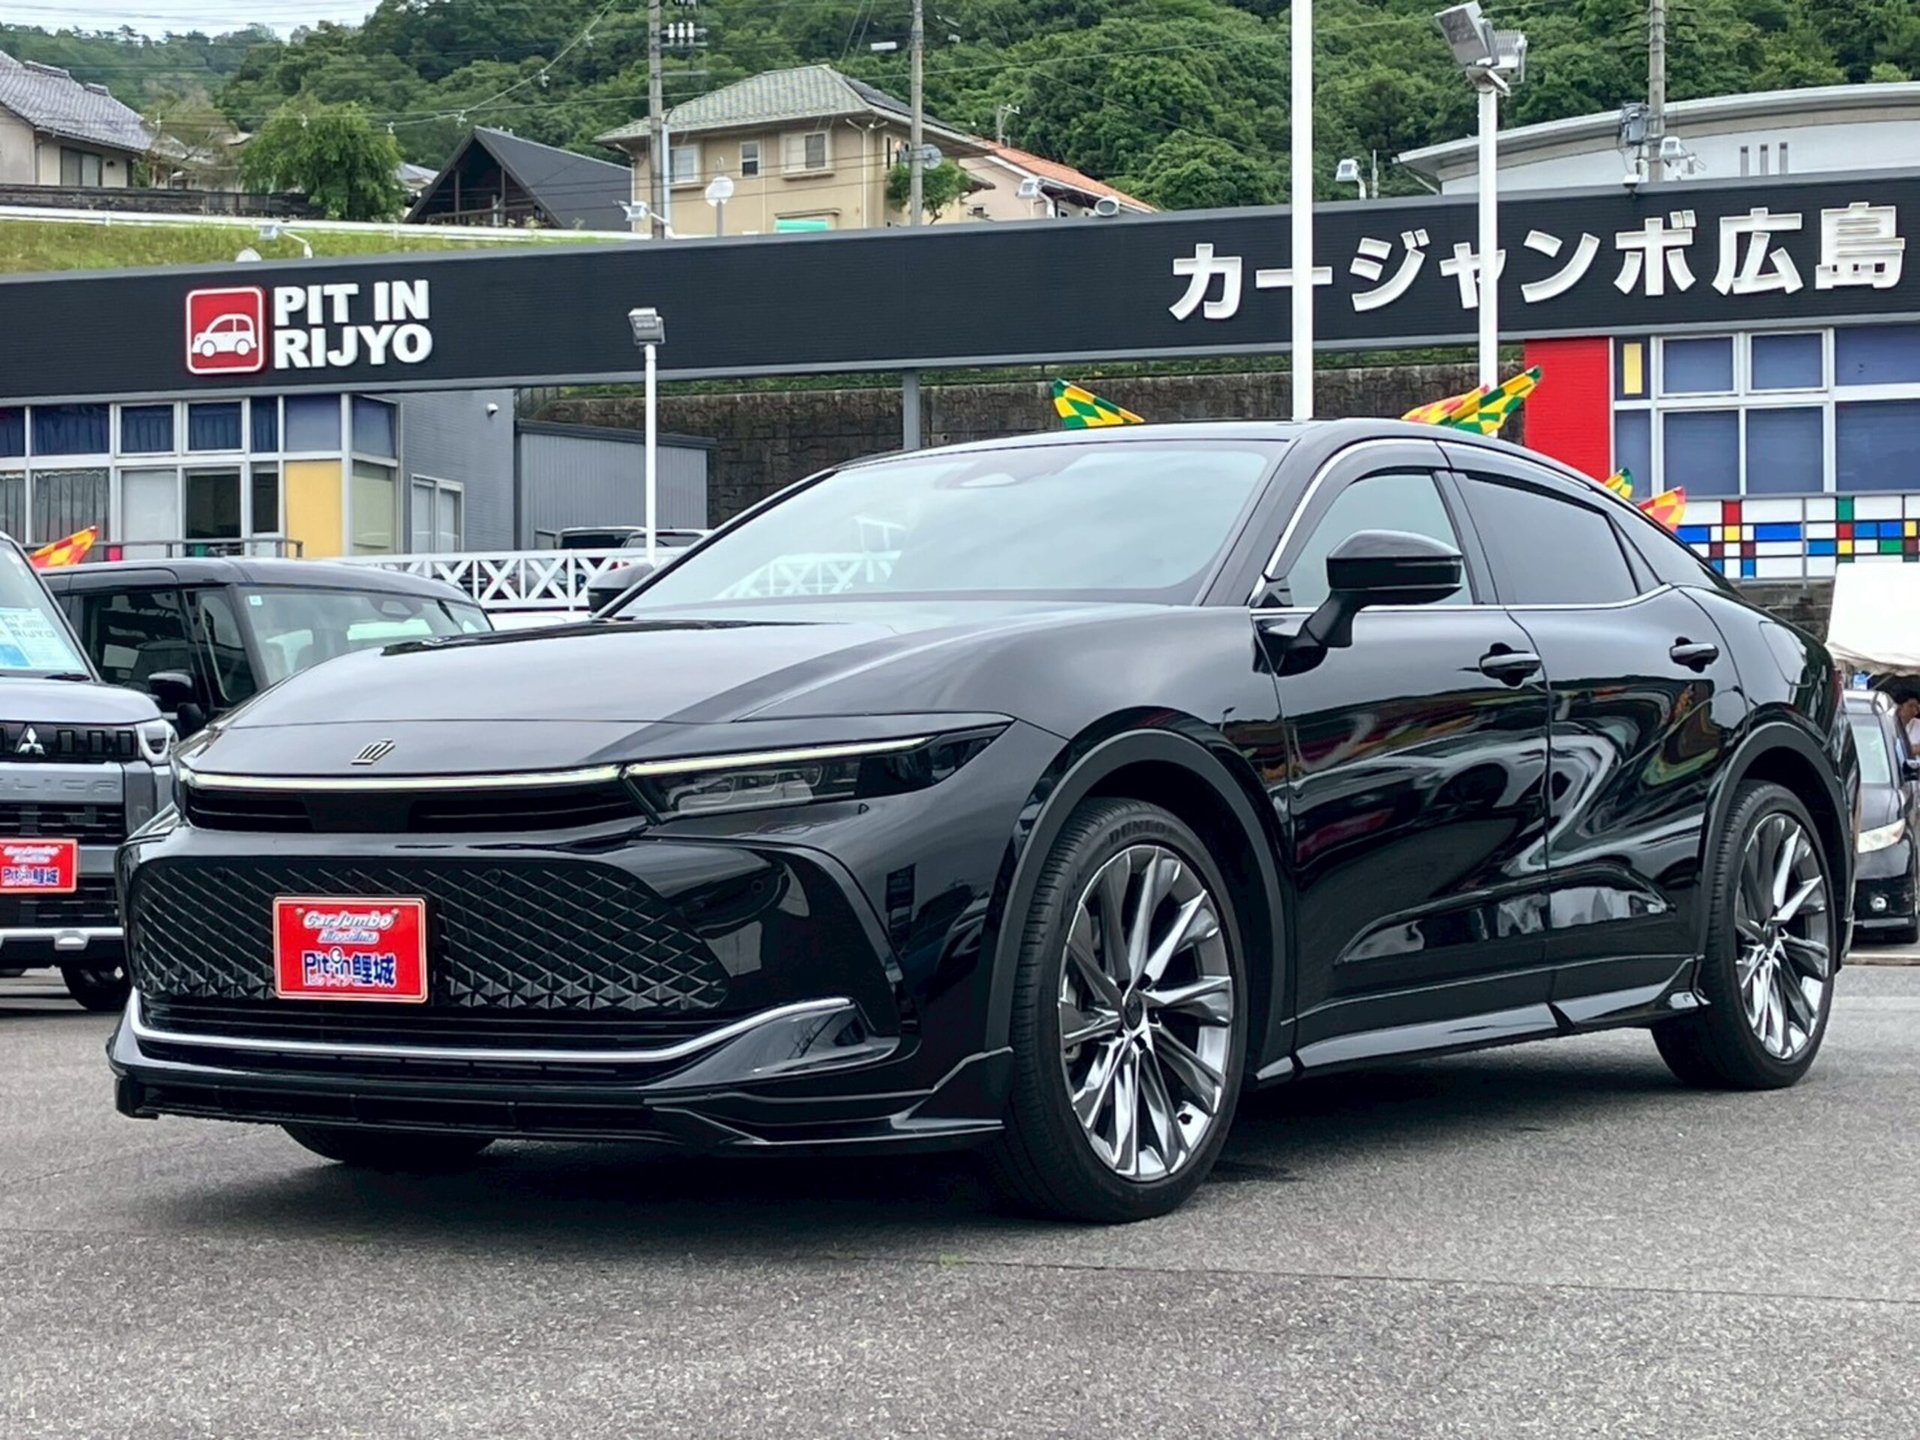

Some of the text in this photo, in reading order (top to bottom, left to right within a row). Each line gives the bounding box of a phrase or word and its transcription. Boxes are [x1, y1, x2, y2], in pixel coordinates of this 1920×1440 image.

[1168, 201, 1906, 321] カージャンボ広島
[273, 279, 430, 326] PIT IN
[273, 323, 433, 370] RIJYO
[0, 777, 119, 793] LICA
